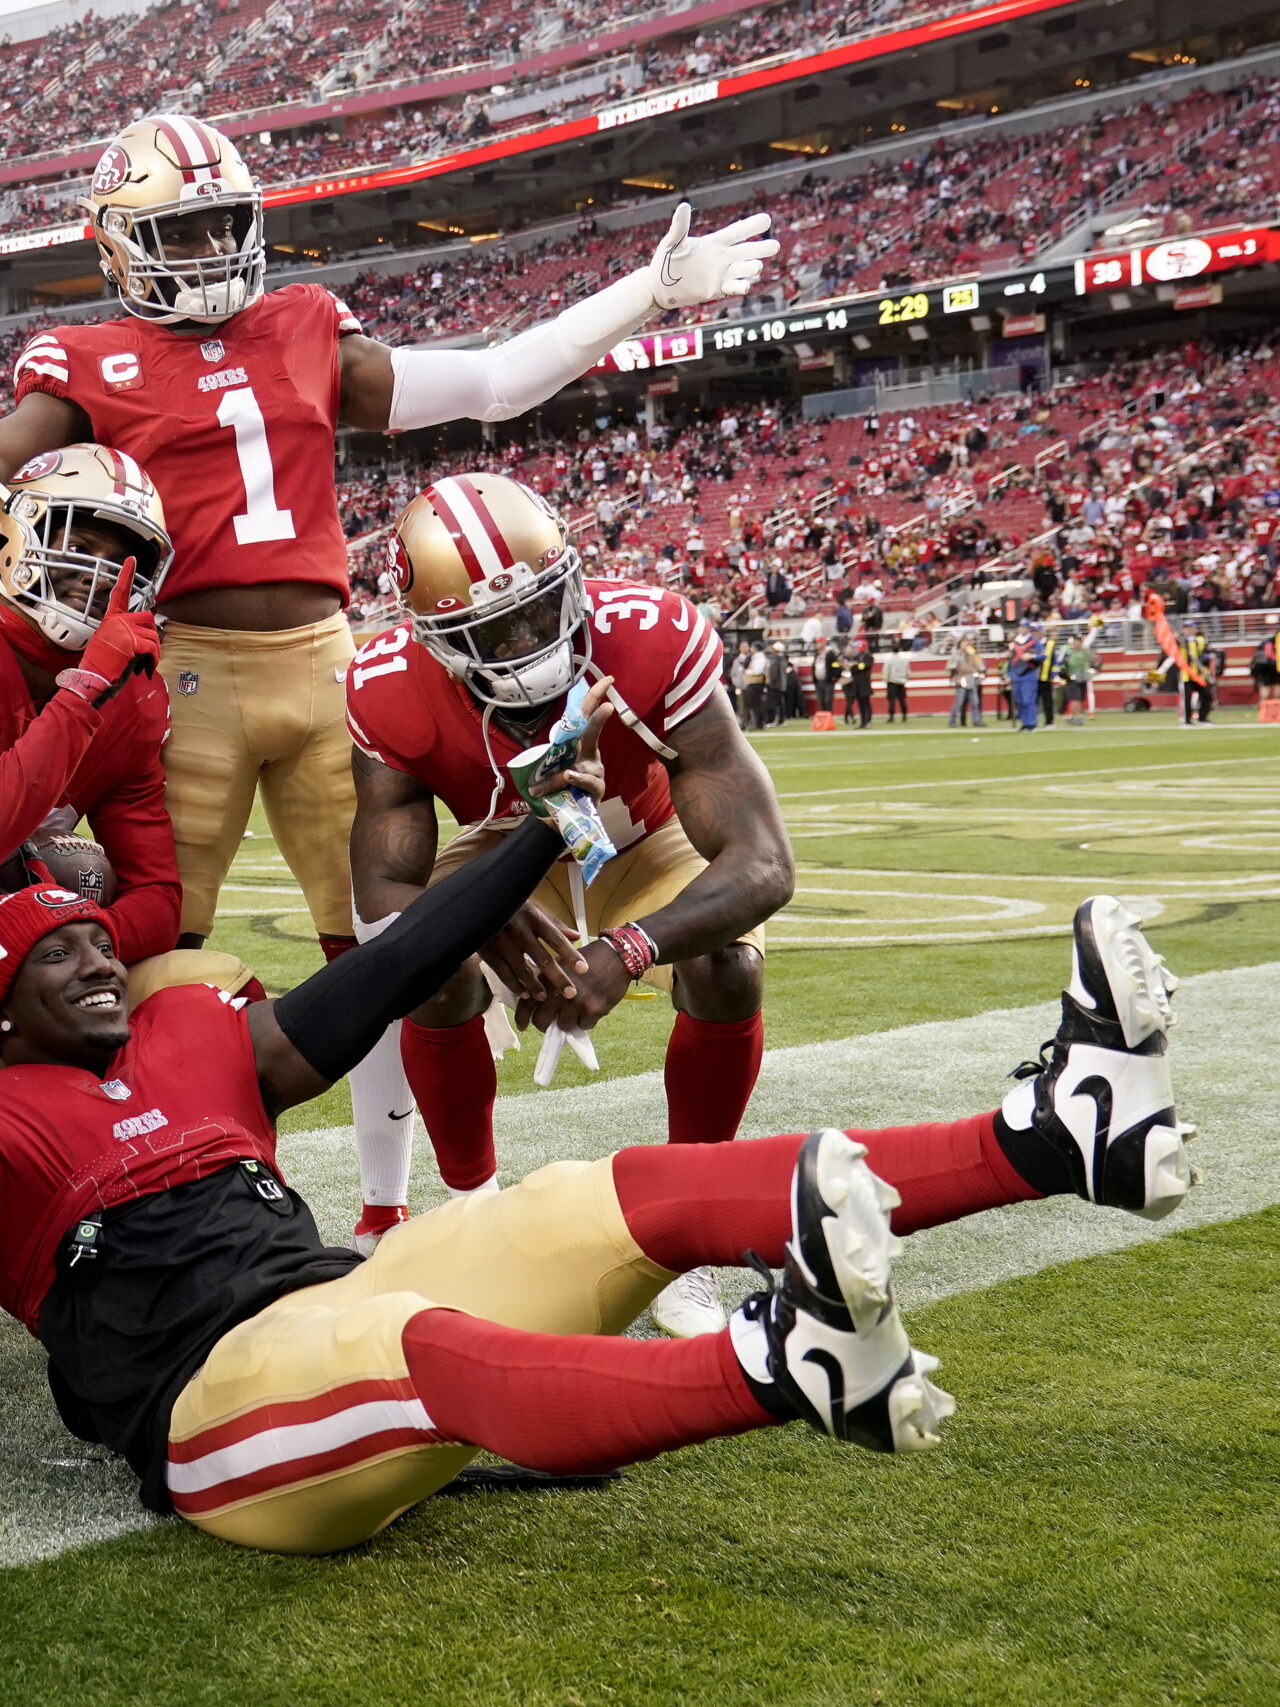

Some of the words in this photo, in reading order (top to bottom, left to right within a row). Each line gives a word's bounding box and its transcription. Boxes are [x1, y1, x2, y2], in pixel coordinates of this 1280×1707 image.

[598, 80, 719, 130] INTERCEPTION
[1244, 239, 1257, 255] 3
[1029, 272, 1047, 295] 4
[878, 293, 929, 325] 2:29
[714, 327, 745, 350] 1ST
[762, 320, 786, 341] 10
[826, 309, 848, 330] 14
[670, 338, 688, 356] 13
[101, 353, 139, 383] C
[197, 367, 248, 392] 49ERS
[216, 387, 297, 545] 1
[594, 587, 665, 634] 31
[352, 627, 410, 691] 31
[112, 1108, 169, 1143] 49ERS
